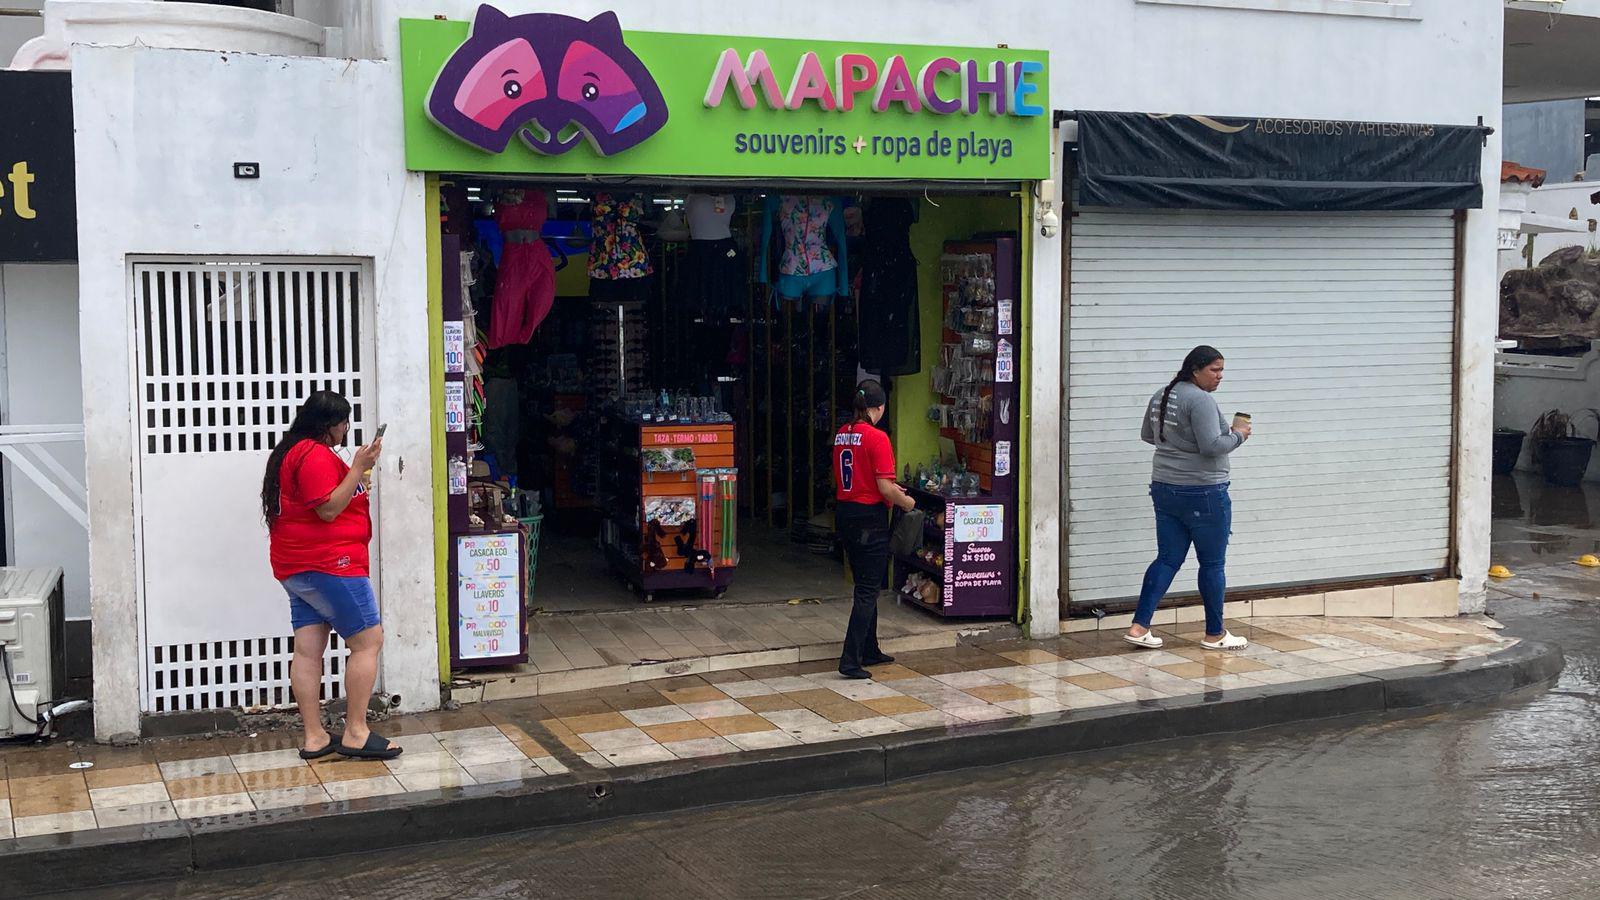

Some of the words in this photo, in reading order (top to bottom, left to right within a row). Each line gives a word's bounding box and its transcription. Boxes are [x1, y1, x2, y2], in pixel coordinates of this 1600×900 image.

[703, 48, 1044, 116] MAPACHE
[1254, 118, 1344, 136] ACCESORIOS
[1347, 121, 1355, 134] Y
[734, 128, 846, 155] souvenirs
[871, 135, 921, 162] ropa
[927, 130, 952, 156] de
[956, 131, 1013, 163] playa
[0, 161, 37, 219] t
[445, 352, 463, 364] 100
[997, 360, 1011, 371] 100
[445, 412, 463, 423] 100
[654, 433, 670, 443] TAZA
[673, 433, 694, 443] TERMO
[698, 432, 718, 443] TARRO
[840, 448, 854, 492] 6
[945, 502, 955, 524] TARRO
[963, 517, 983, 525] CASACA
[470, 548, 494, 557] CASACA
[495, 547, 508, 556] ECO
[974, 553, 996, 562] $100
[486, 558, 500, 571] 50
[955, 580, 972, 588] ROPA
[983, 579, 1002, 587] PLAYA
[473, 590, 504, 599] LLAVEROS
[943, 584, 954, 607] FIESTA
[488, 599, 499, 612] 10
[487, 639, 499, 652] 10
